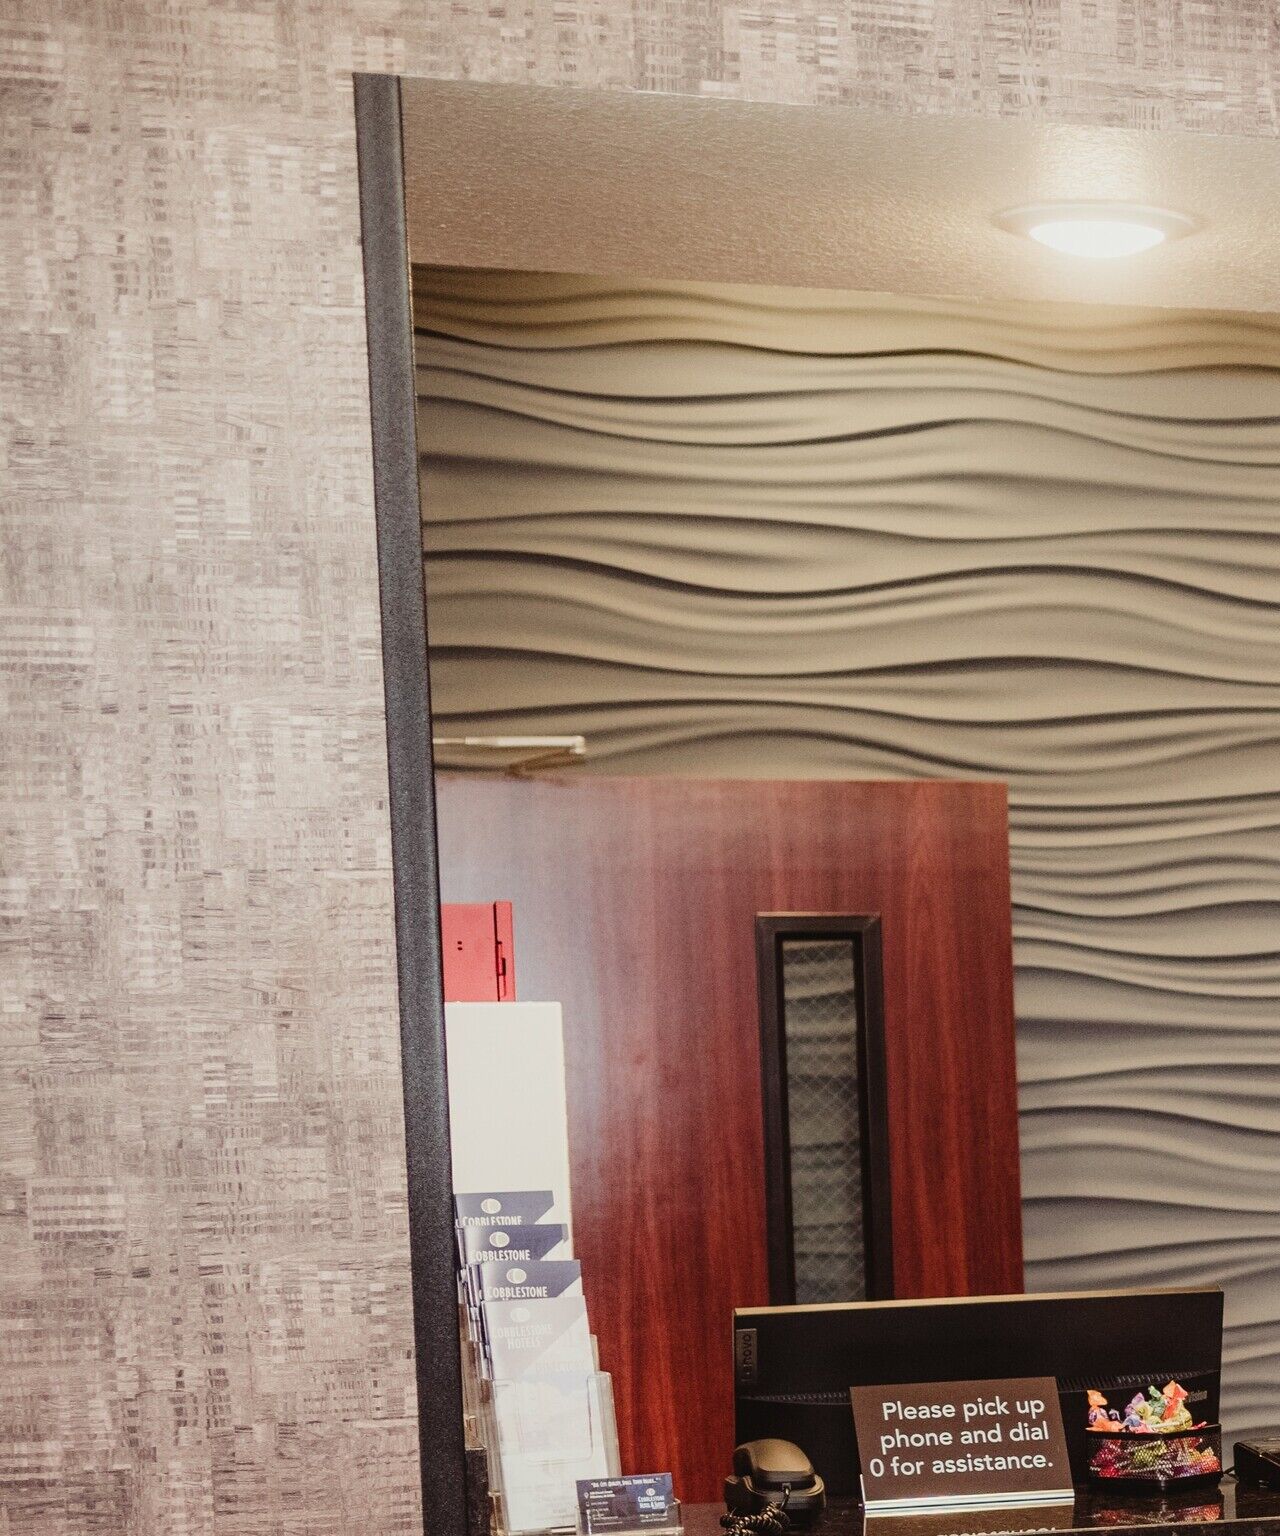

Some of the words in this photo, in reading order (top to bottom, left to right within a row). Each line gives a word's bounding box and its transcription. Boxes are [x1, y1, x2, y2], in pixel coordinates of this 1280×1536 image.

[881, 1400, 955, 1421] Please
[963, 1396, 1009, 1422] pick
[1016, 1398, 1045, 1418] up
[880, 1428, 953, 1455] phone
[960, 1423, 1002, 1445] and
[1009, 1420, 1049, 1442] dial
[869, 1457, 885, 1478] 0
[890, 1456, 924, 1477] for
[932, 1452, 1054, 1474] assistance.
